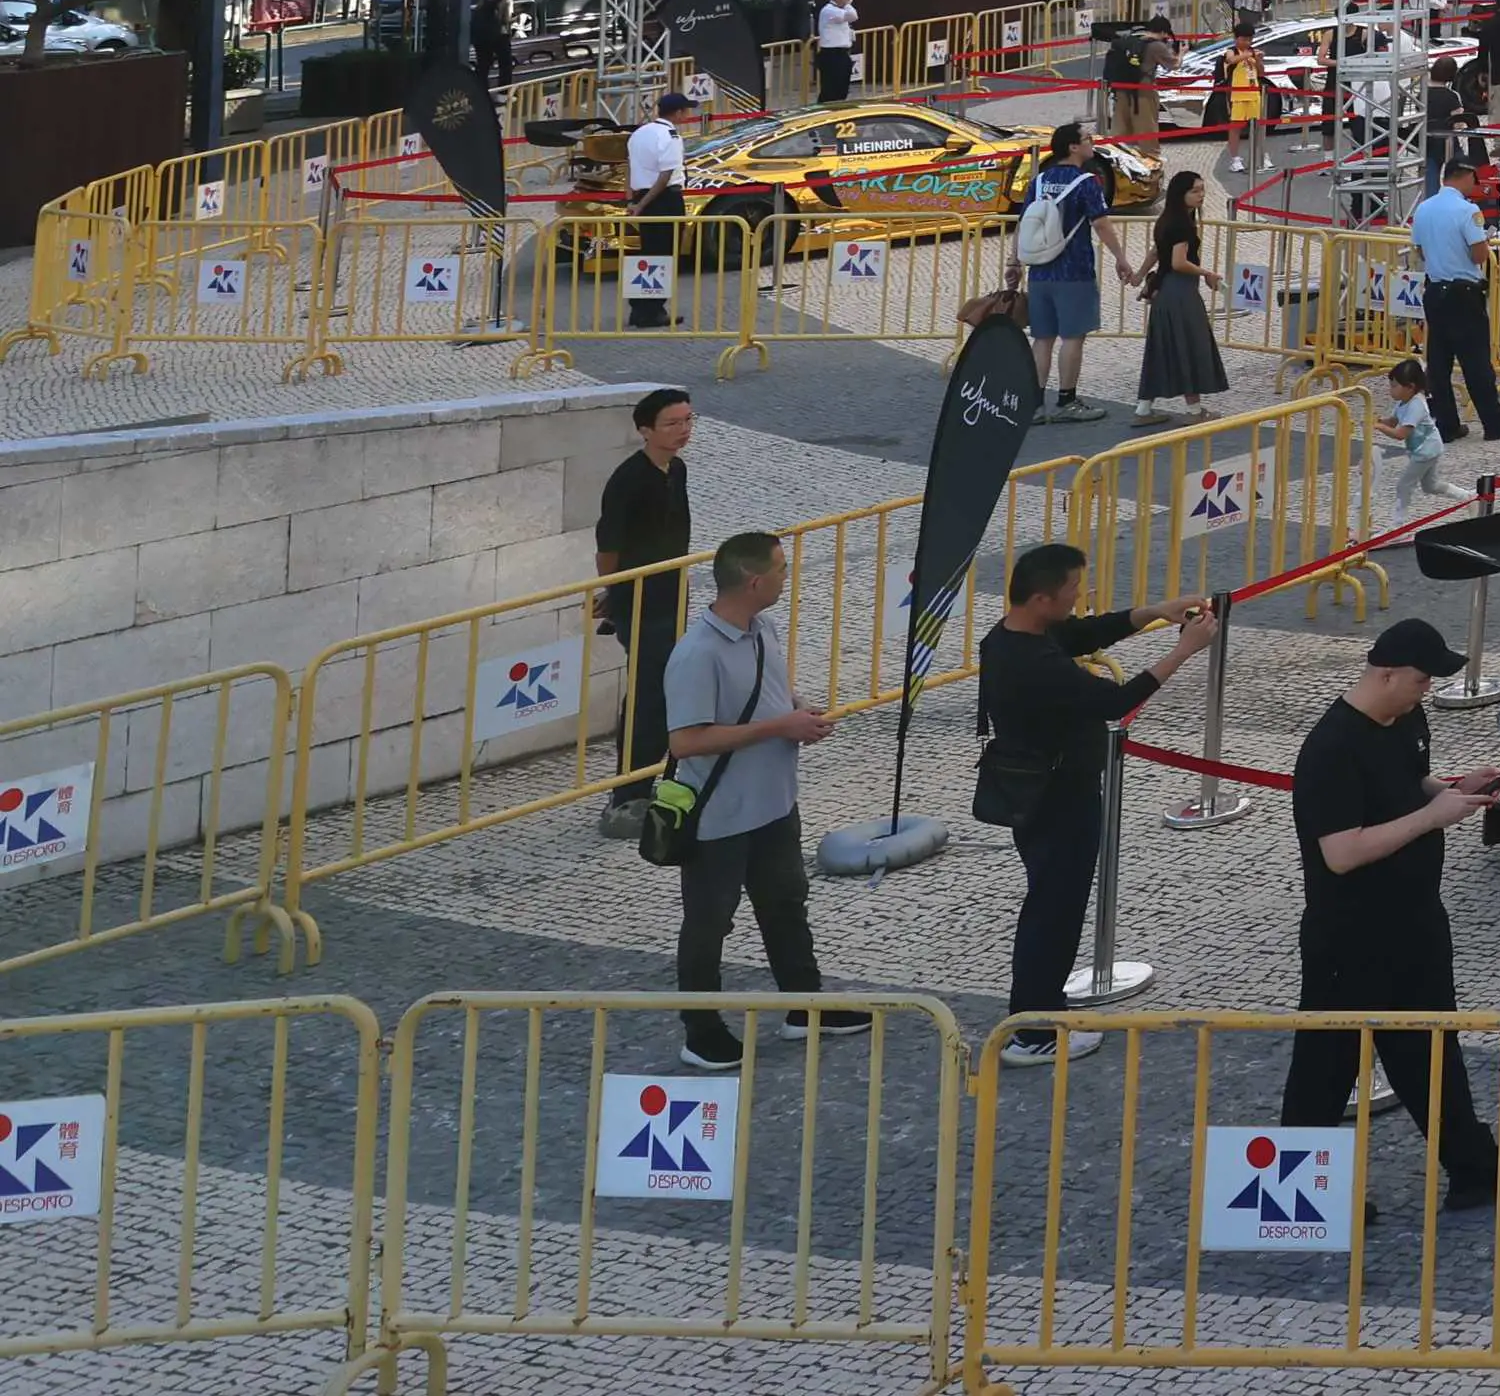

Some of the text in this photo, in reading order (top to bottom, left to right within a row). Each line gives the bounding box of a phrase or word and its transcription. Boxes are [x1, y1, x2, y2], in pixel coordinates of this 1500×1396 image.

[836, 122, 857, 138] 22
[893, 173, 999, 202] LOVERS
[516, 700, 560, 720] DESPORTO
[57, 786, 75, 816] 體育
[3, 841, 67, 868] DESPORTO
[701, 1099, 718, 1141] 體育
[60, 1120, 78, 1161] 體育
[647, 1172, 712, 1192] DESPORTO
[1313, 1159, 1330, 1191] 體育
[1258, 1224, 1327, 1240] DESPORTO
